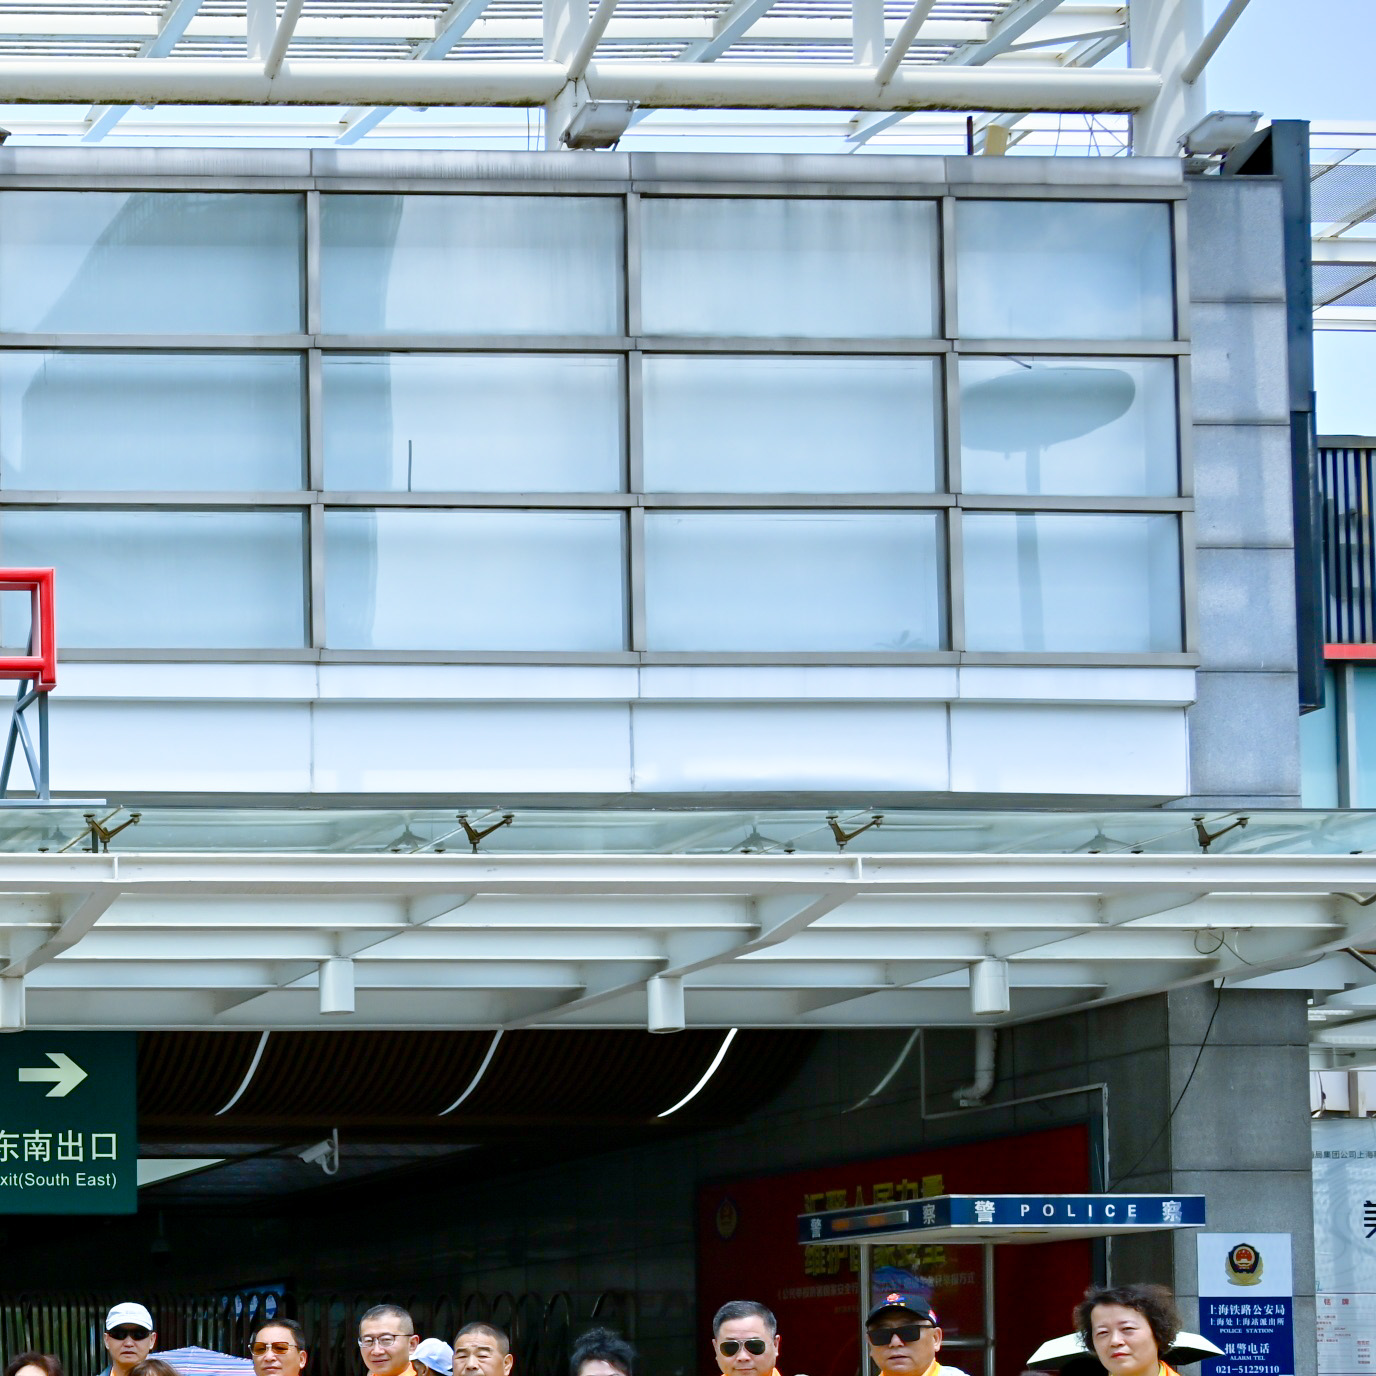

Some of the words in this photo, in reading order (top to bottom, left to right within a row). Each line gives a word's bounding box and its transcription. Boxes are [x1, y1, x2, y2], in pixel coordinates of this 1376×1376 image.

[76, 1172, 117, 1190] East)
[974, 1200, 996, 1223] 警
[1020, 1204, 1138, 1218] POLICE
[1210, 1303, 1285, 1316] 上海铁路公安局
[1224, 1342, 1270, 1355] 报警电话
[1215, 1365, 1280, 1374] 021-51229110
